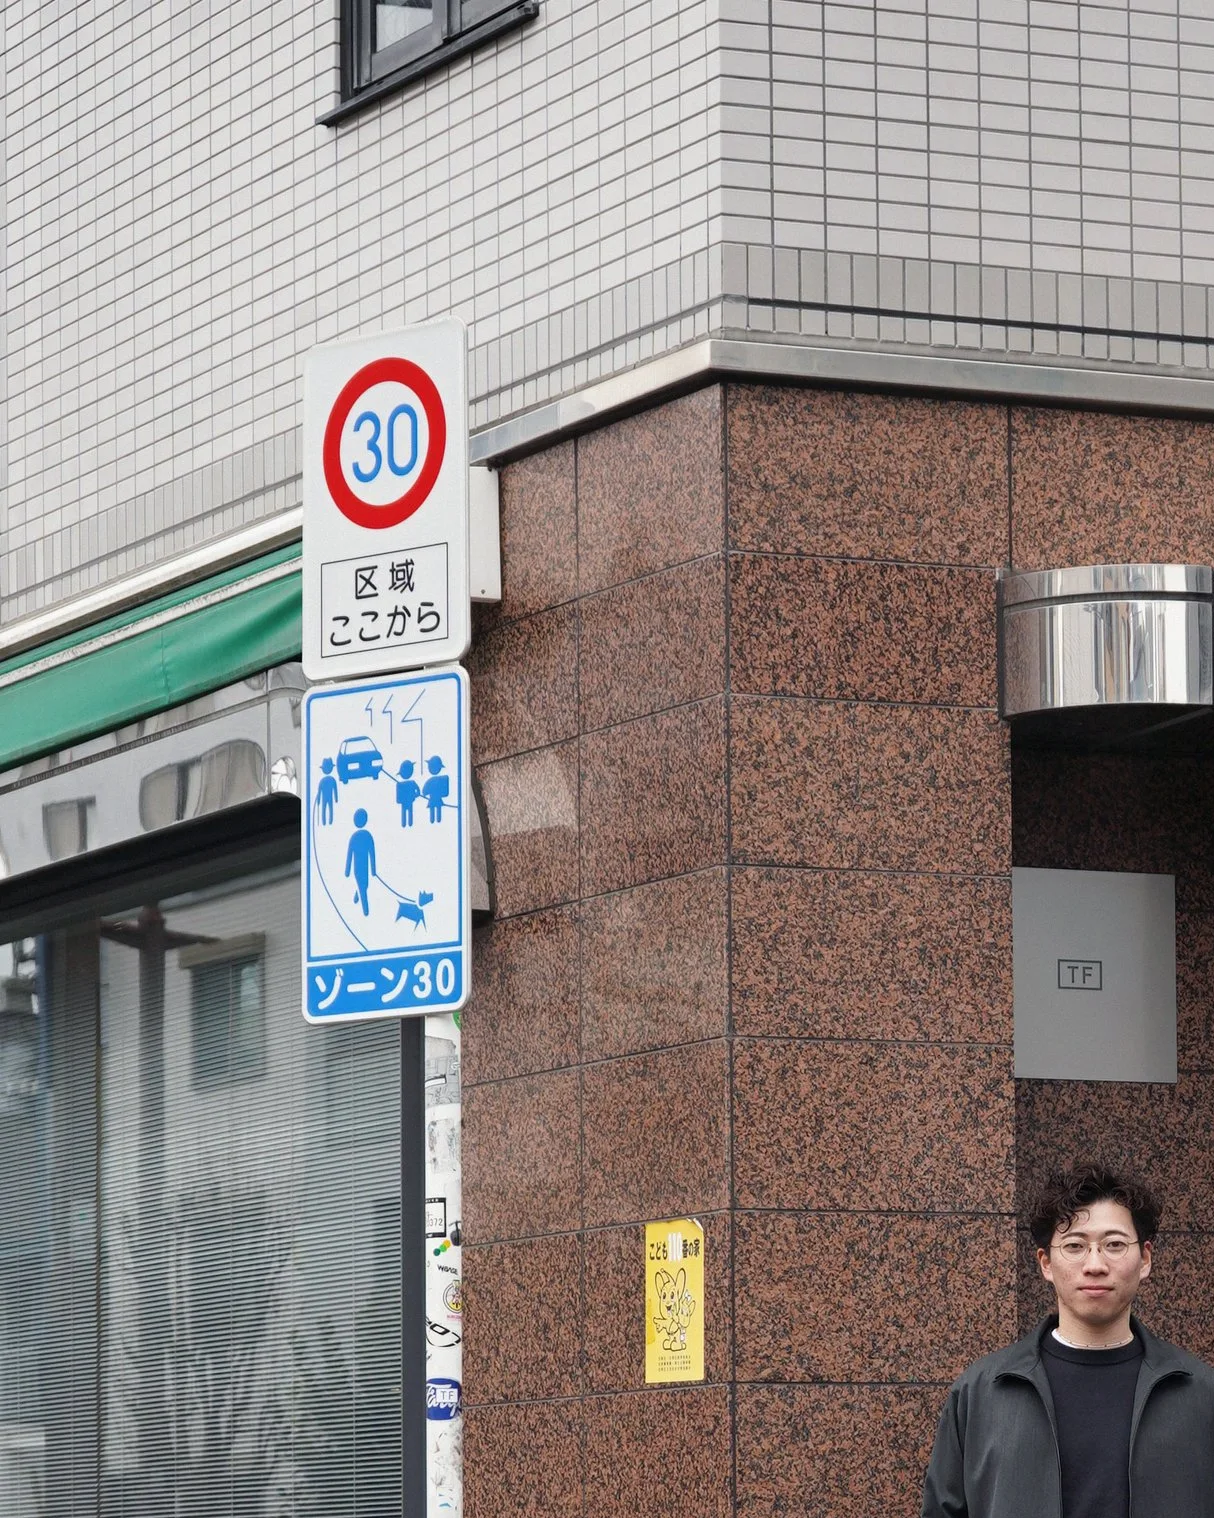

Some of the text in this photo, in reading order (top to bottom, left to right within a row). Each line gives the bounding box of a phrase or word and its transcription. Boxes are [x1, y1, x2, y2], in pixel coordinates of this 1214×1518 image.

[352, 403, 418, 483] 30
[355, 558, 415, 600] 区域
[330, 602, 441, 646] ここから
[315, 958, 455, 1010] ゾーン30
[1067, 965, 1093, 984] TF
[440, 1391, 454, 1400] TF
